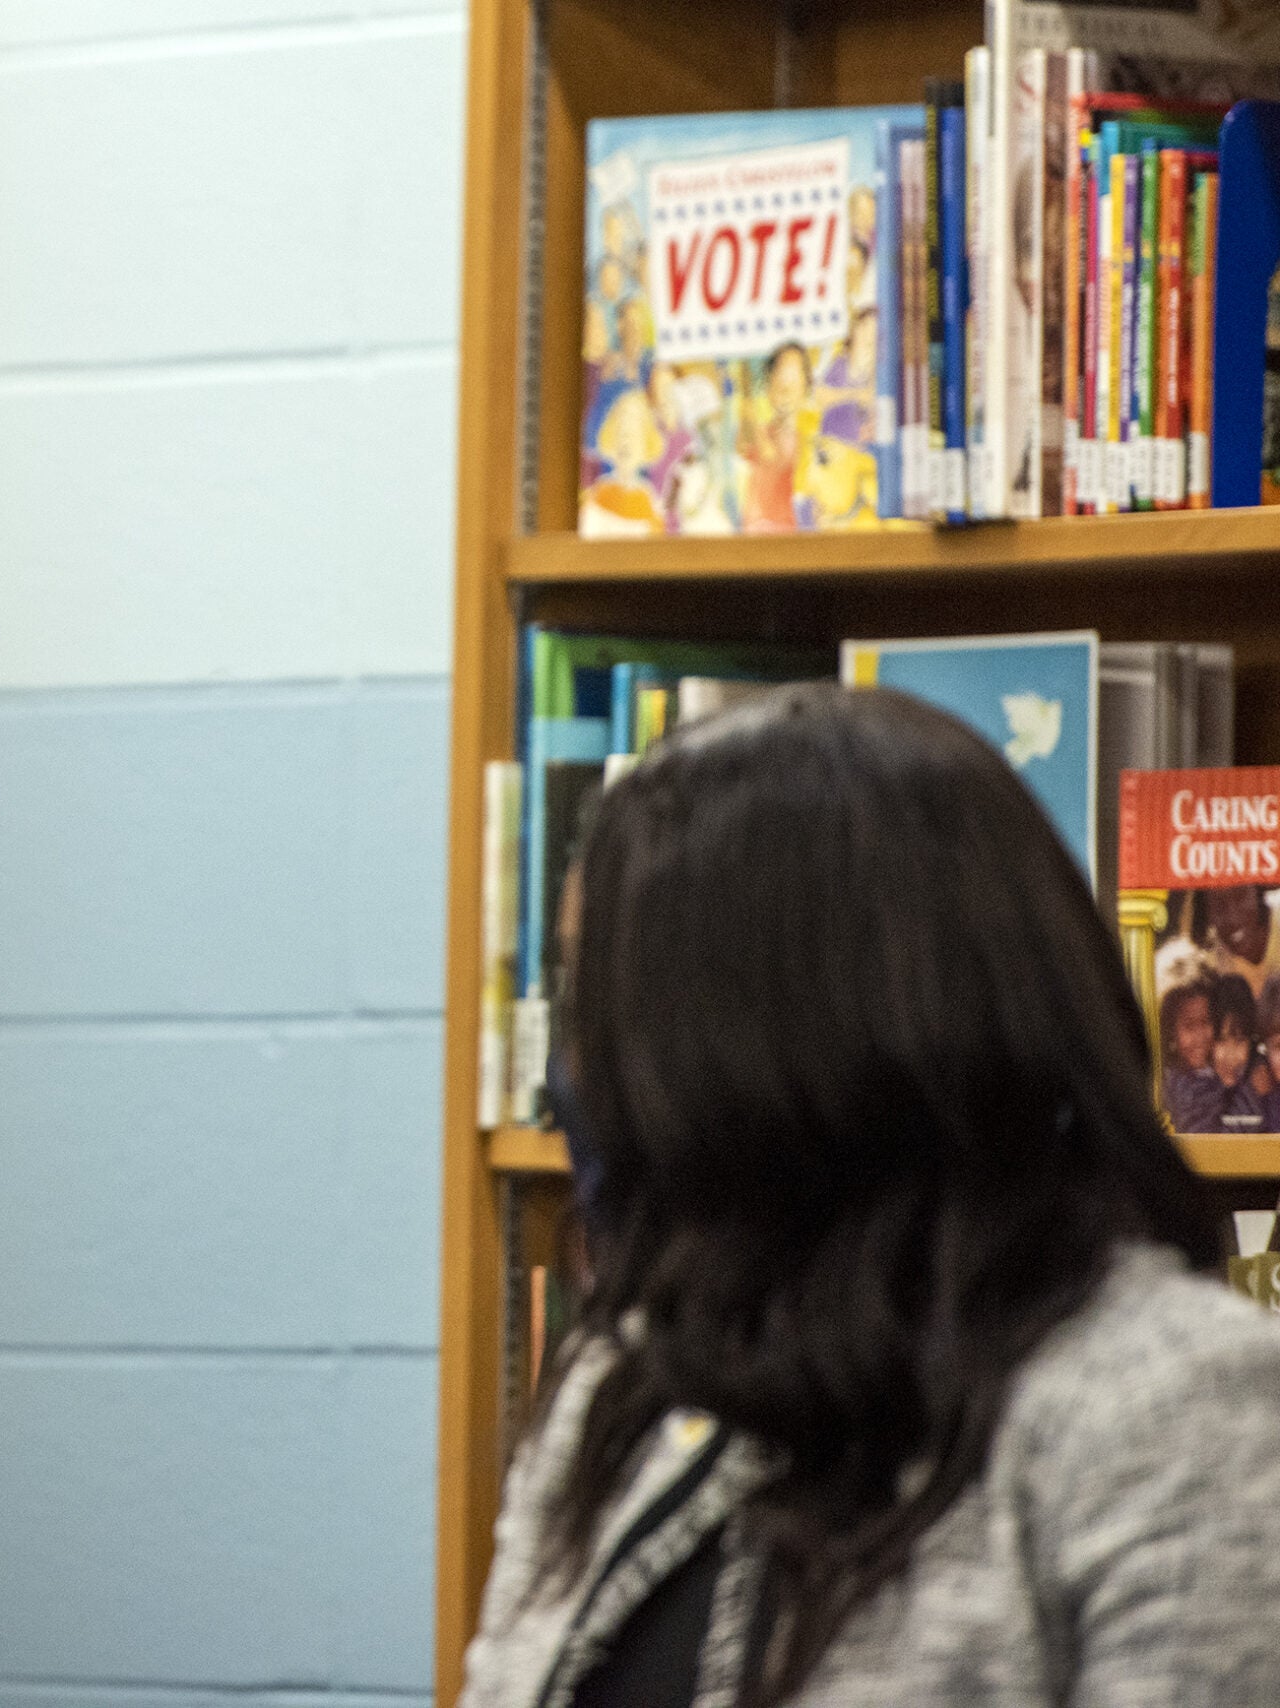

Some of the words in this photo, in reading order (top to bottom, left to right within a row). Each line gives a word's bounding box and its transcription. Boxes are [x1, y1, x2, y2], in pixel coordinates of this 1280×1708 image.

[666, 212, 838, 315] VOTE!
[1172, 789, 1279, 833] CARING
[1171, 834, 1279, 879] COUNTS
